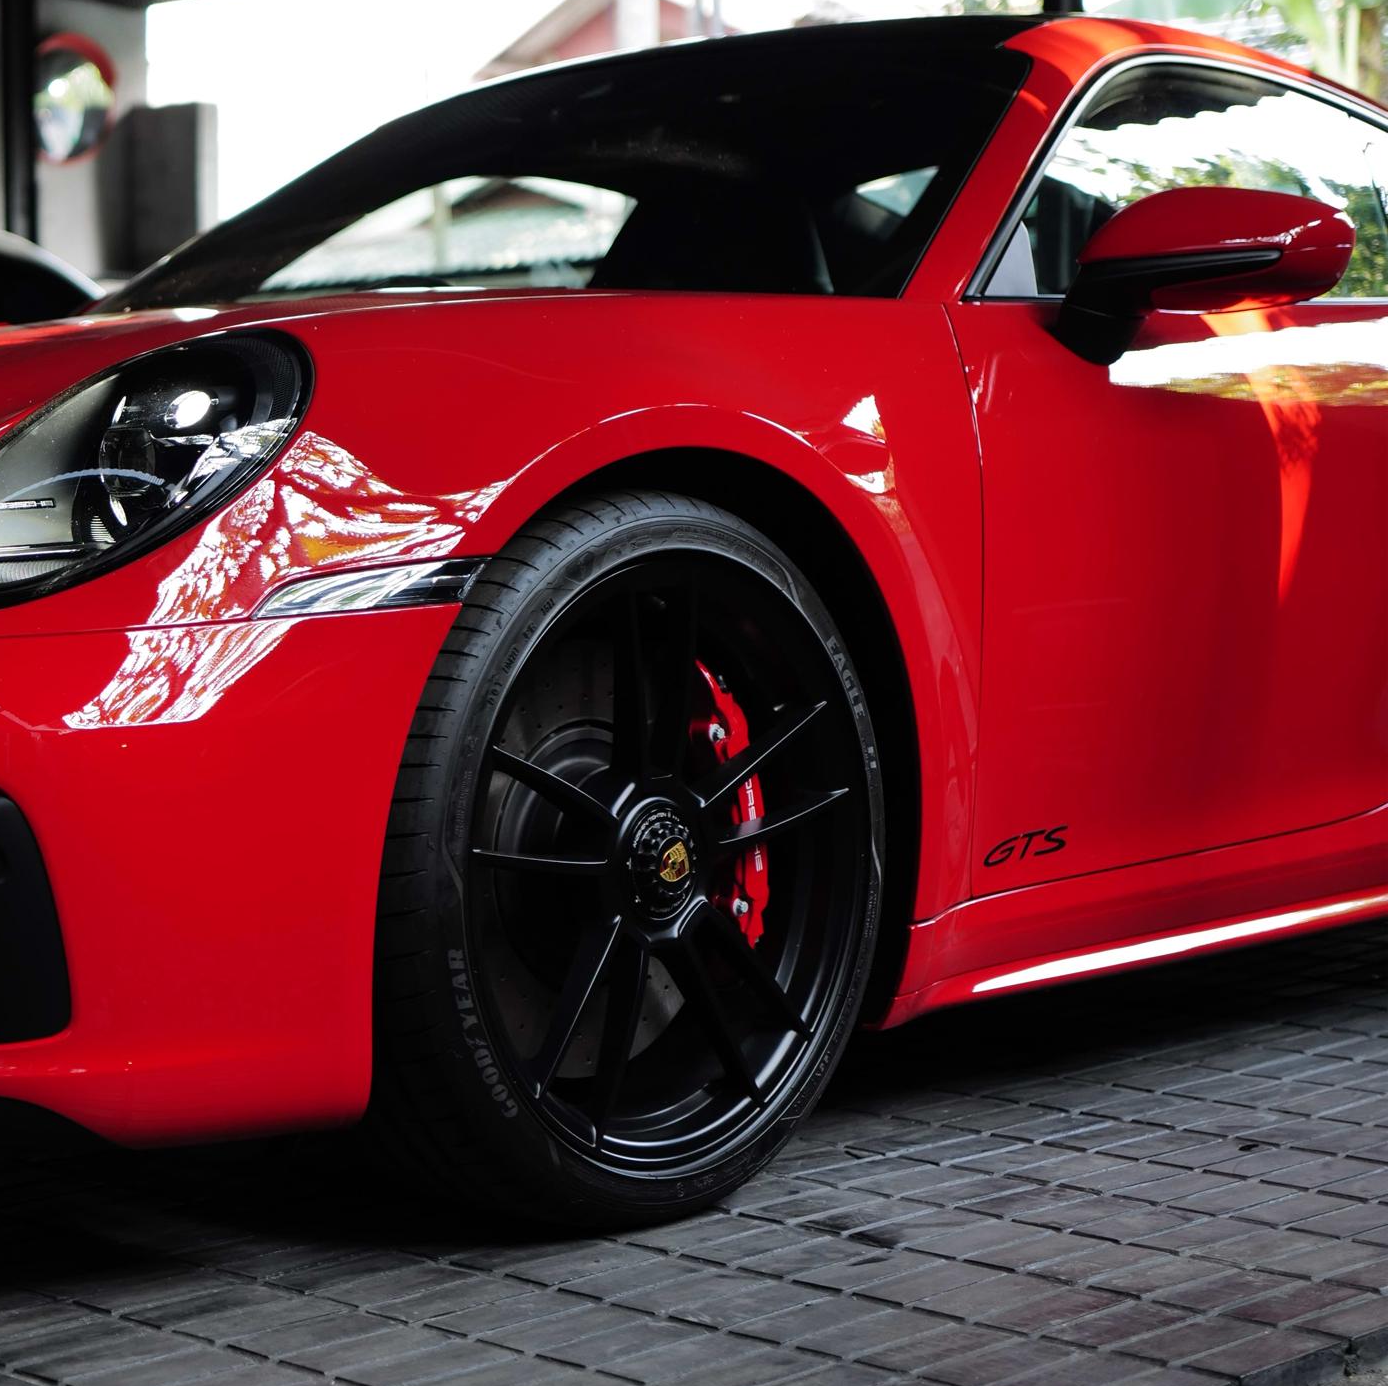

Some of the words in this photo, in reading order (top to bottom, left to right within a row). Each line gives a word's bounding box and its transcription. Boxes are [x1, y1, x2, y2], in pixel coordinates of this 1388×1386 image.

[826, 635, 866, 719] EAGLE
[983, 824, 1069, 867] GTS
[446, 949, 518, 1117] GOODYEAR
